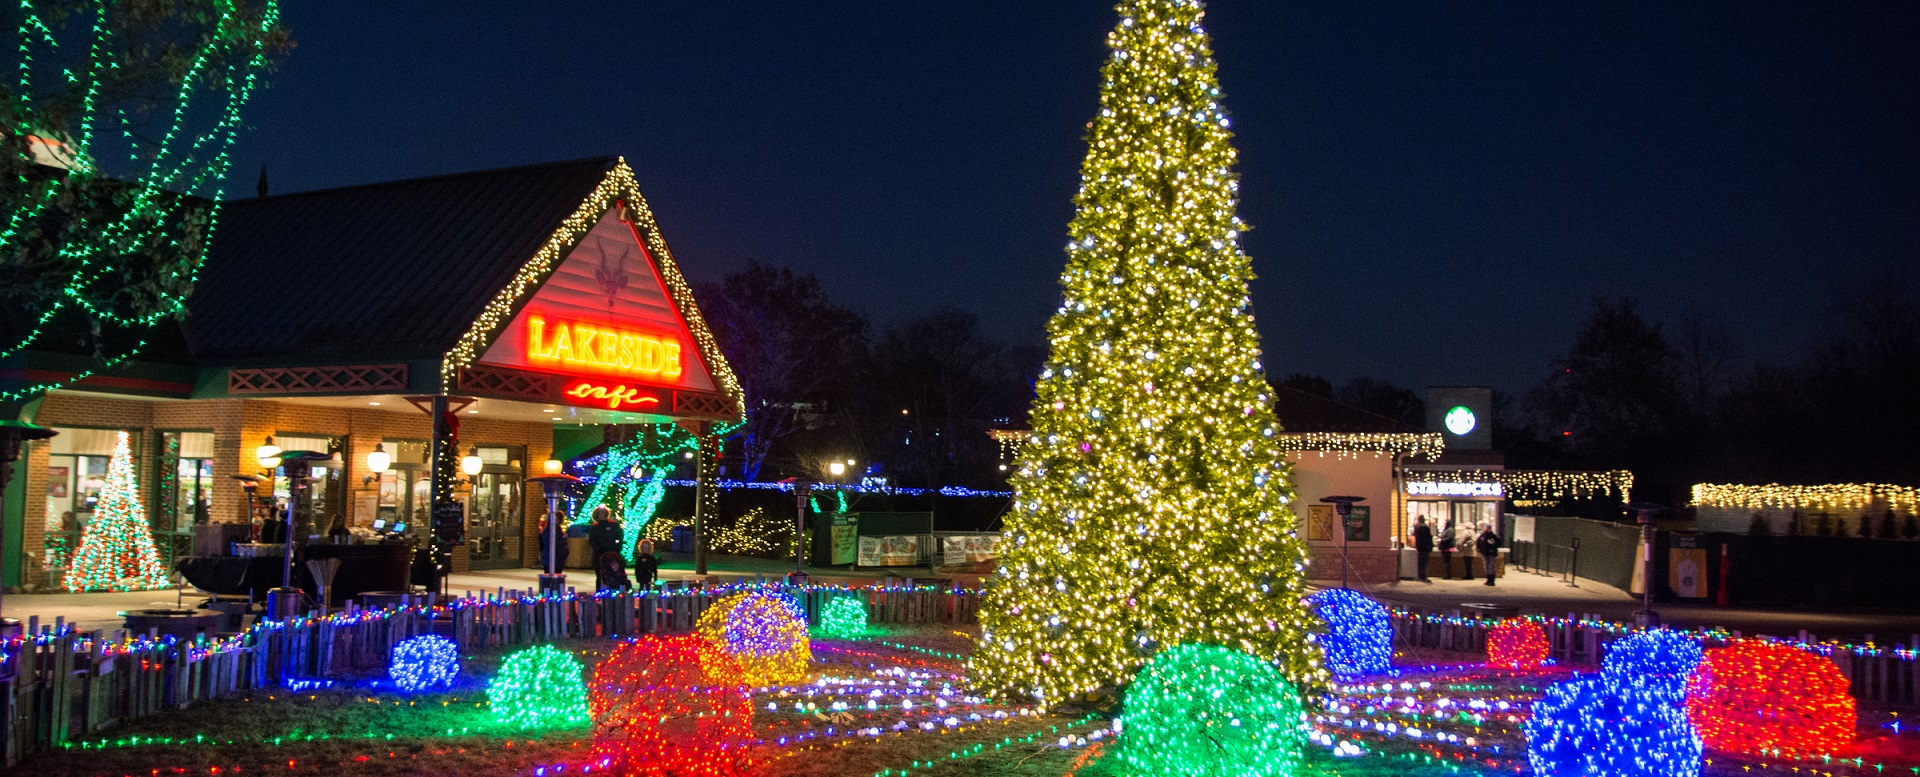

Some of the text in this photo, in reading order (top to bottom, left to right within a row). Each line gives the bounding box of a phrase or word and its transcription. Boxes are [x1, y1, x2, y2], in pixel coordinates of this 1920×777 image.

[529, 318, 682, 376] LAKESIDE
[567, 383, 659, 408] cafe
[1407, 482, 1502, 496] STARBUCKS
